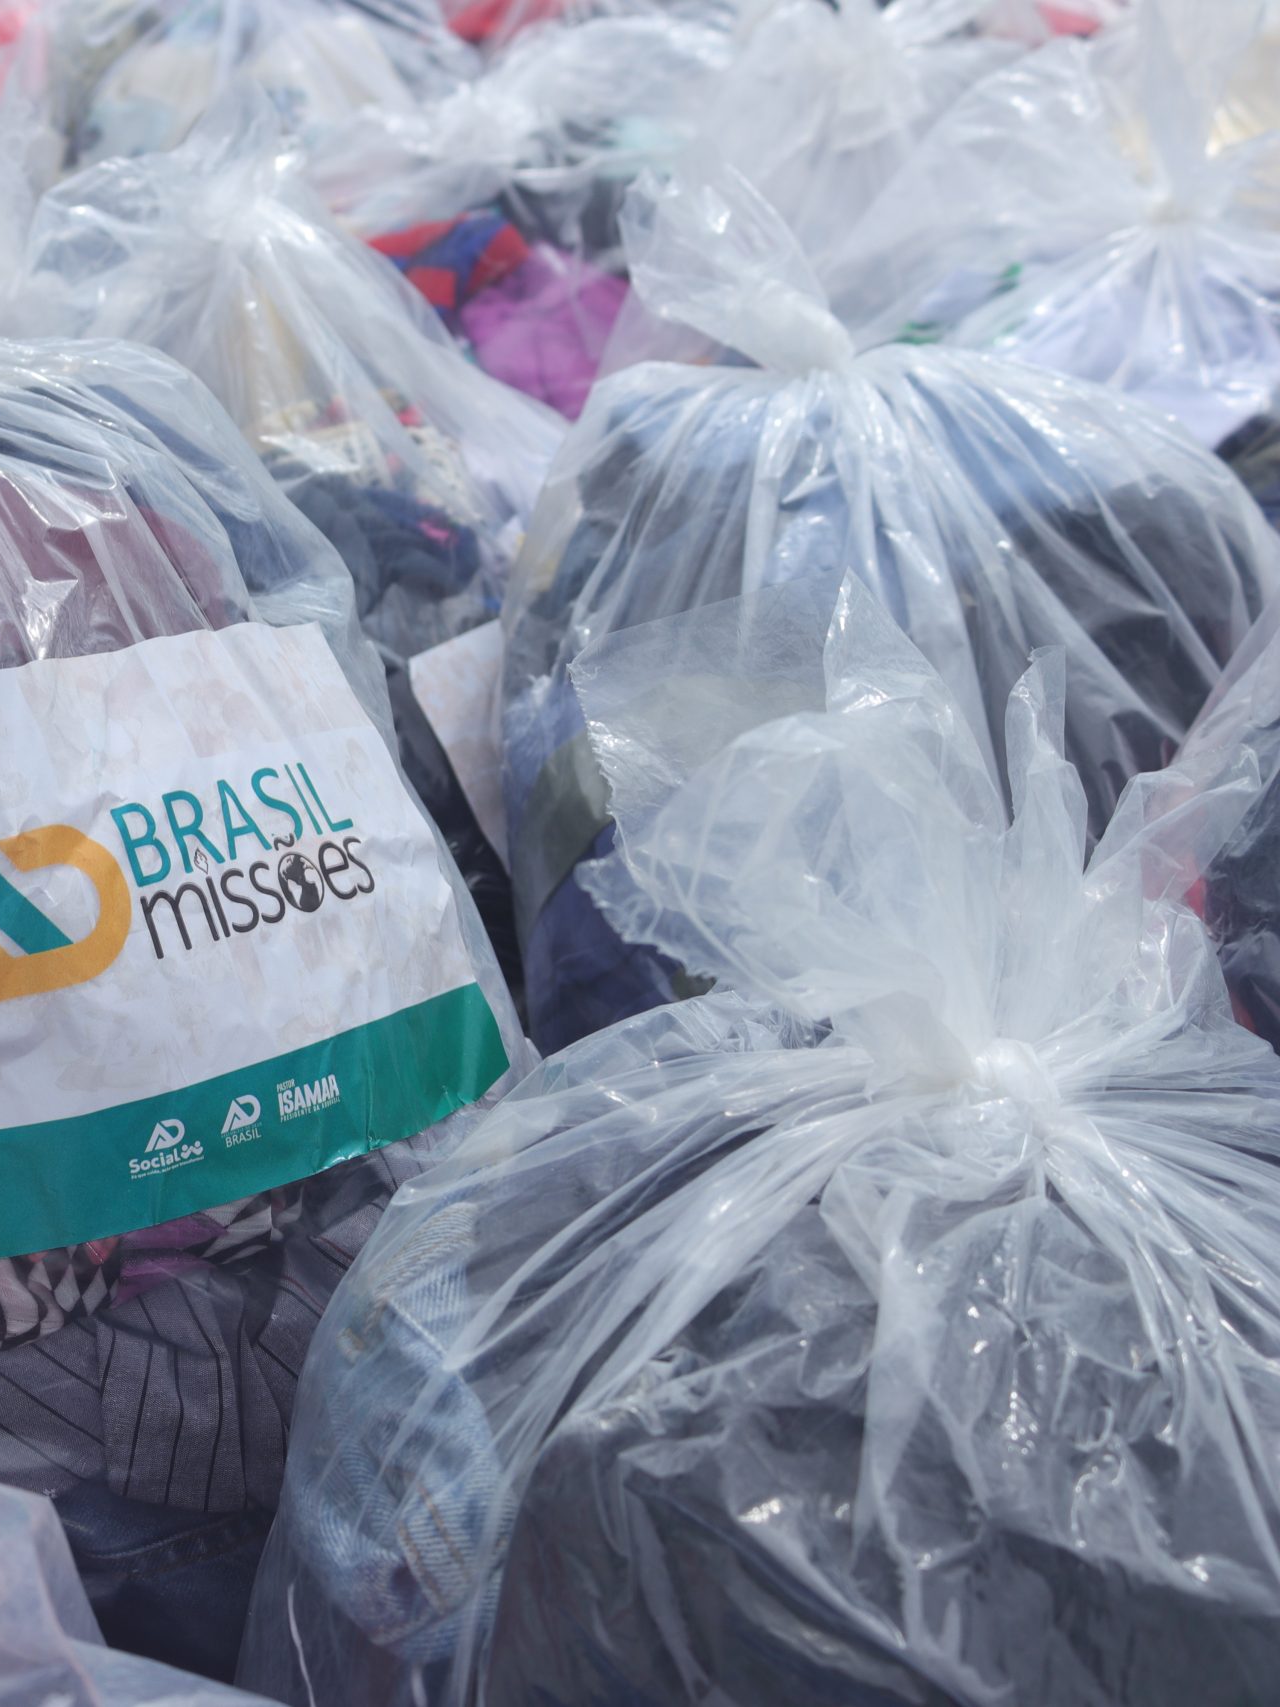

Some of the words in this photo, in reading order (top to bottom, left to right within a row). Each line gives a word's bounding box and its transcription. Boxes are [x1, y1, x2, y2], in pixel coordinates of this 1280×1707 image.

[110, 762, 354, 888] BRASIL
[140, 833, 375, 960] missões
[277, 1074, 340, 1116] ISAMAR
[225, 1127, 262, 1148] BRASIL
[129, 1148, 181, 1174] Social
